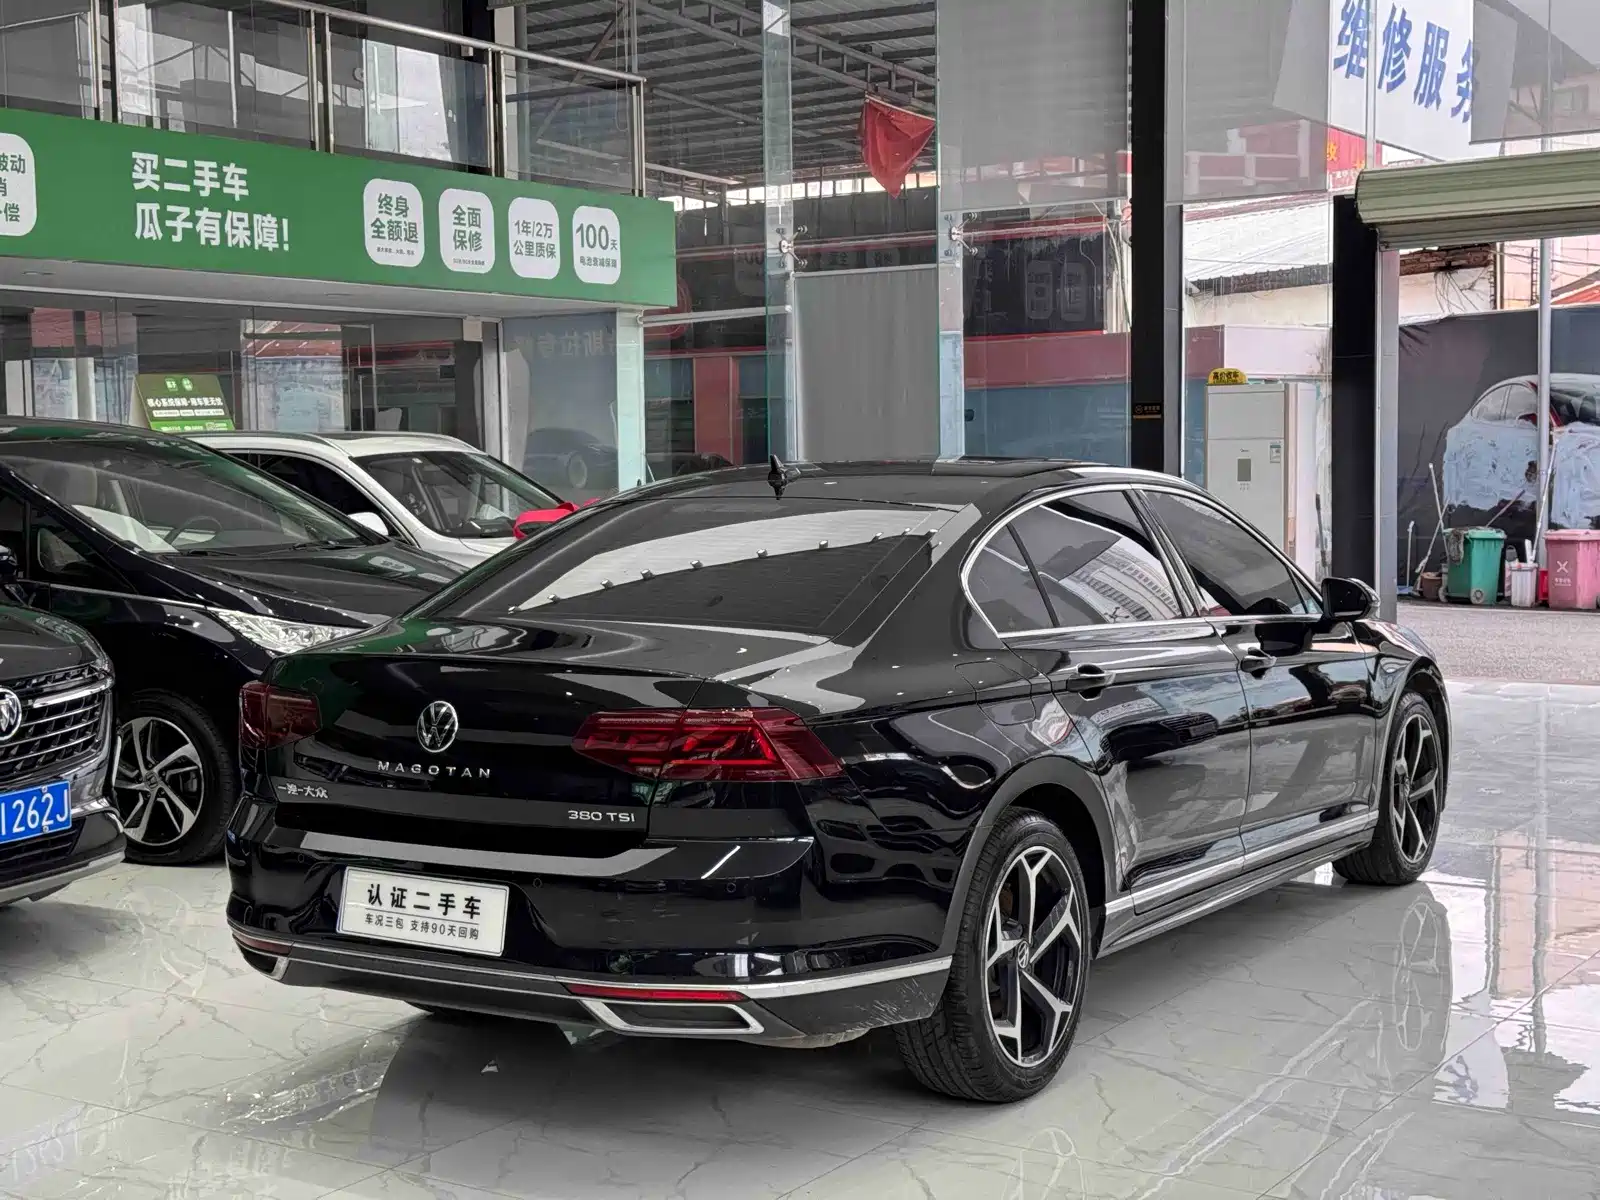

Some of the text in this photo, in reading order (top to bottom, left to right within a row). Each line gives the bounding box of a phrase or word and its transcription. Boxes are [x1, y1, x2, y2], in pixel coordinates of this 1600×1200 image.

[132, 152, 249, 201] 买二手车
[377, 193, 409, 218] 终身
[452, 204, 482, 228] 全面
[135, 203, 289, 251] 瓜子有保障!
[370, 217, 419, 243] 全额退
[452, 229, 483, 252] 保修
[513, 240, 557, 259] 公里质保
[377, 761, 490, 778] MAGOTAN
[568, 810, 635, 822] 380 TSI
[367, 883, 482, 920] 认证二手车
[365, 913, 479, 940] 车况三包 支持90天回购
